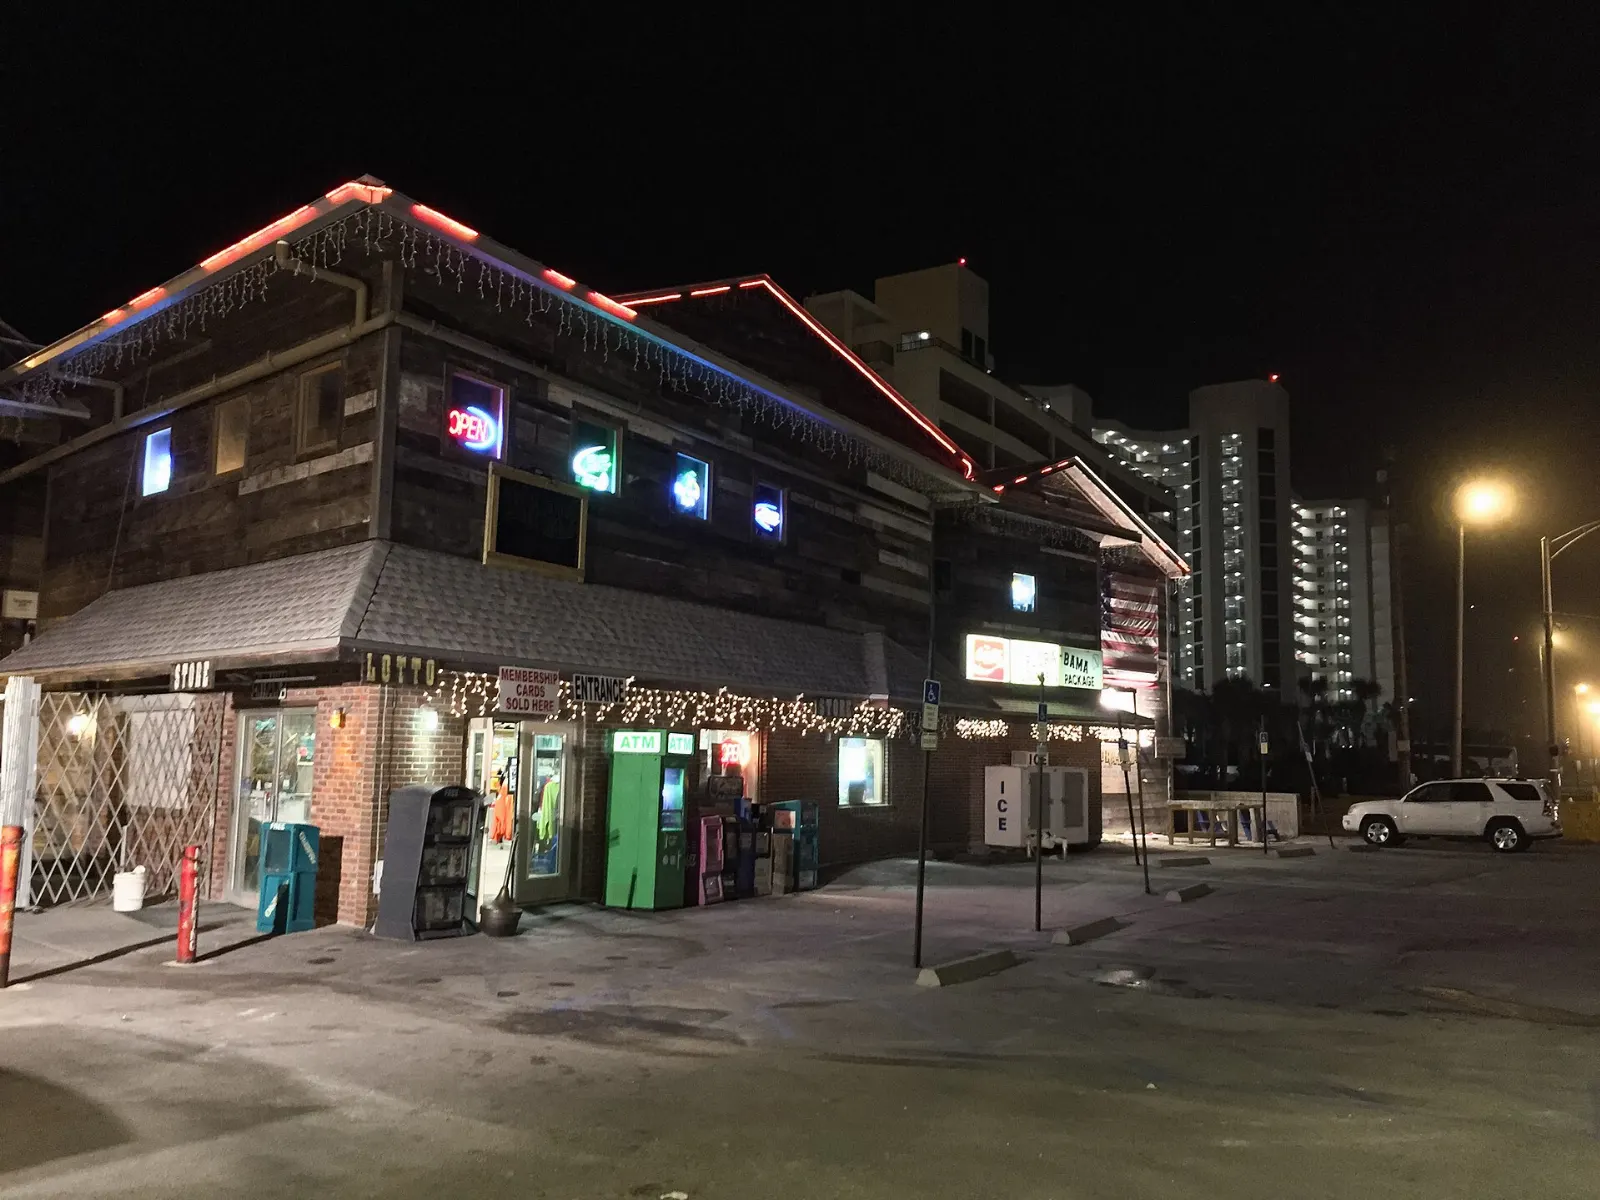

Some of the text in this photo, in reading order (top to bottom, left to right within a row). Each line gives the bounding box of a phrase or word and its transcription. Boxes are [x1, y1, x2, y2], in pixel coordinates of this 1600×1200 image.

[447, 408, 489, 442] OPEN
[174, 660, 210, 690] STORE
[366, 652, 435, 687] LOTTO
[500, 668, 559, 685] MEMBERSHIP
[574, 675, 625, 703] ENTRANCE
[1064, 673, 1095, 687] PACKAGE
[516, 684, 546, 698] CARDS
[506, 697, 555, 712] SOLD HERE
[818, 698, 852, 717] STORE
[620, 735, 656, 749] ATM
[669, 736, 692, 751] ATM
[997, 780, 1008, 831] ICE
